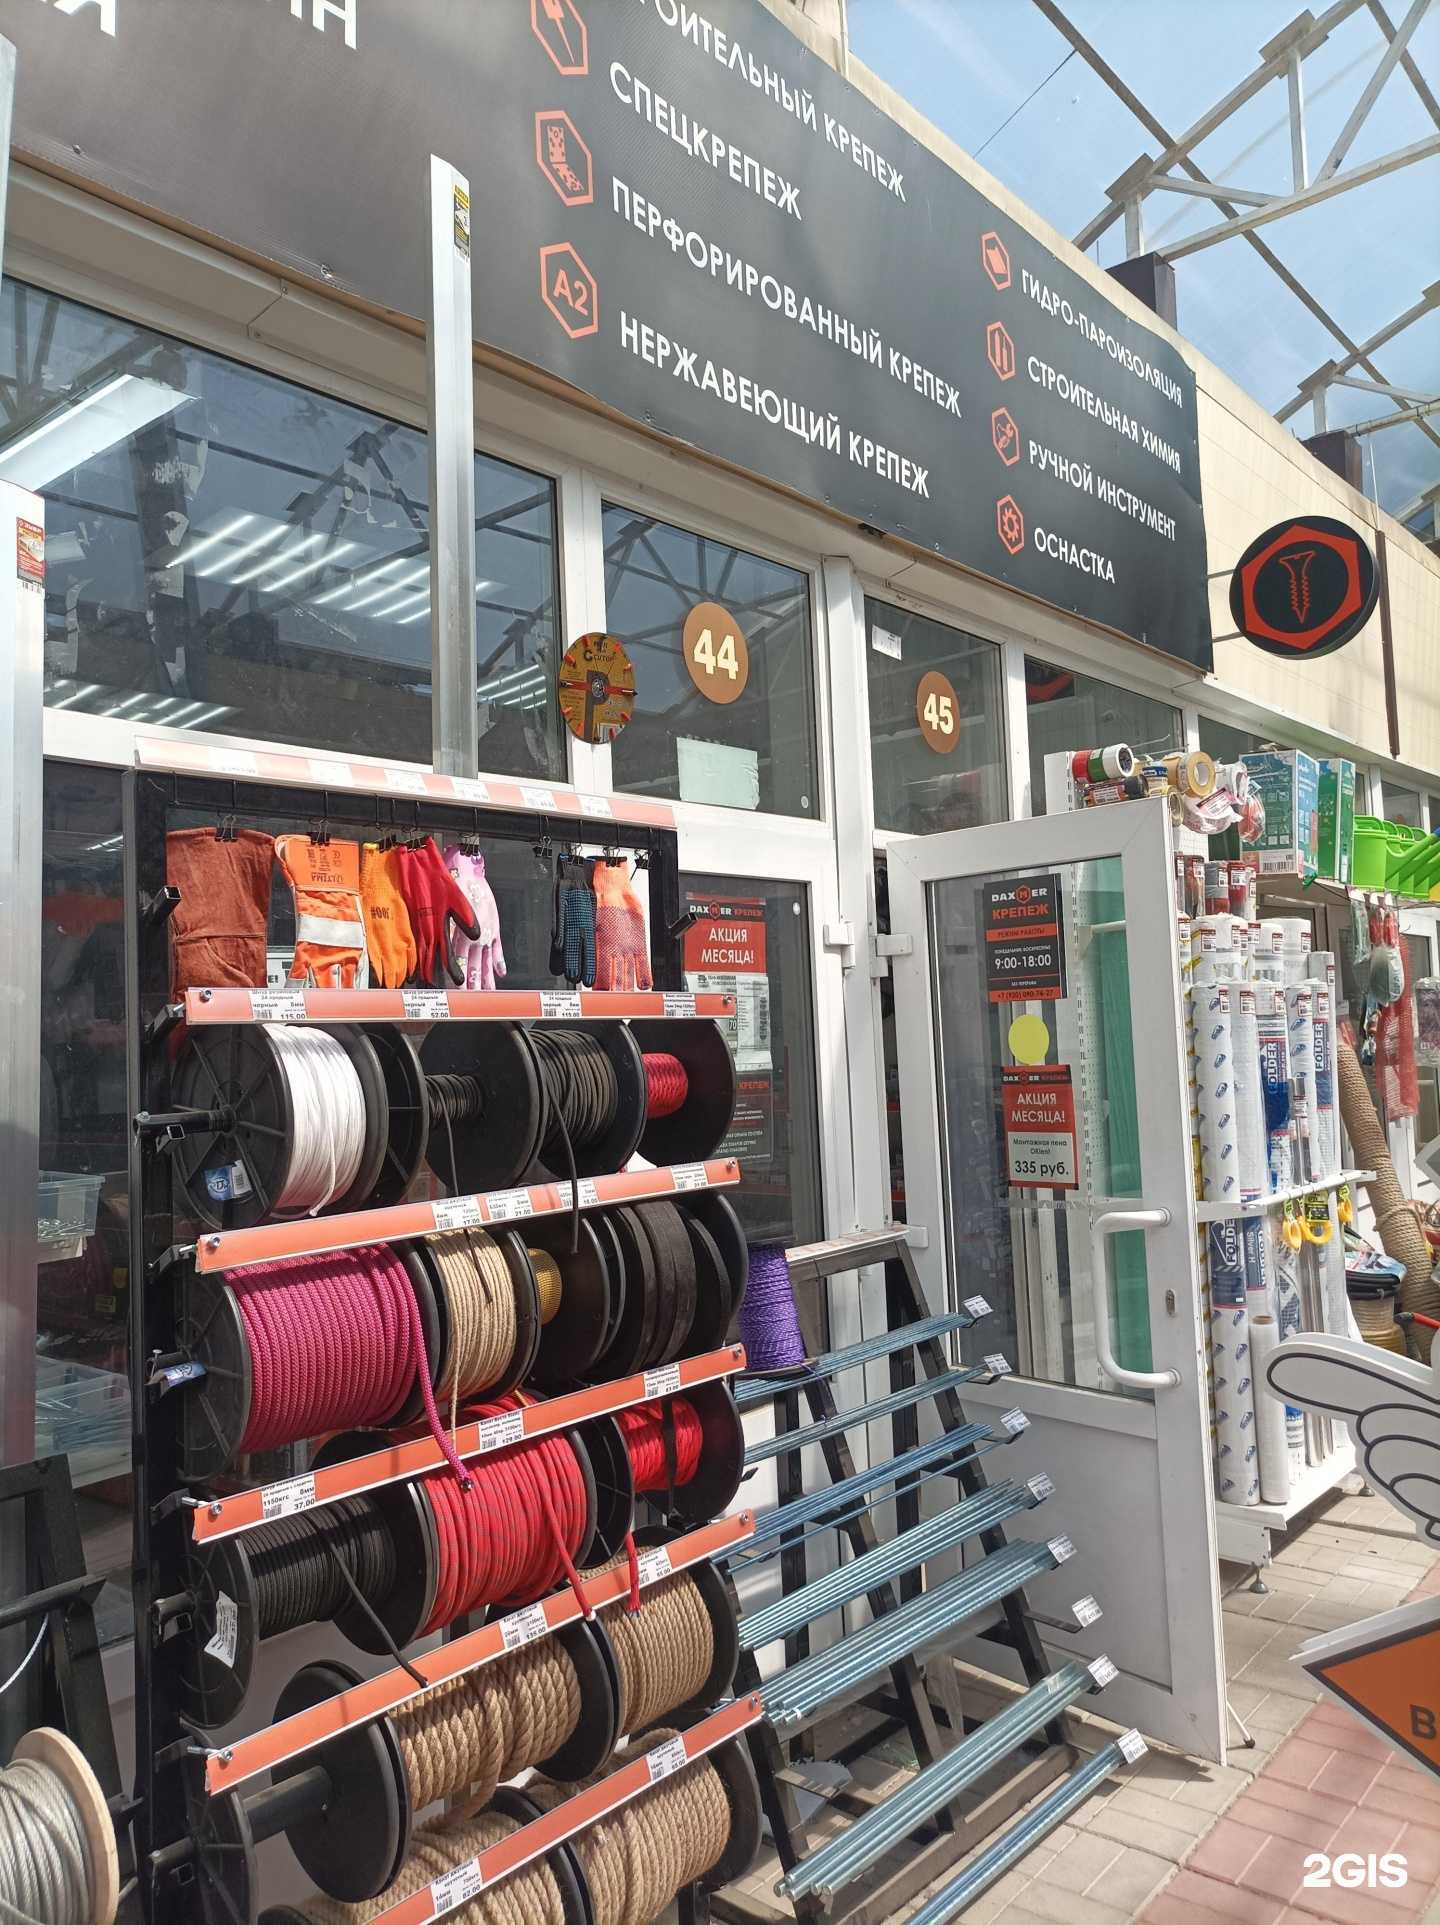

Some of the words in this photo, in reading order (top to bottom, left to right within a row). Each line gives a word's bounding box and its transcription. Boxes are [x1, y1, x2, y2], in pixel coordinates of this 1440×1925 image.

[639, 0, 817, 132] ОИТЕЛЬНЫЙ
[824, 113, 906, 202] КРЕПЕЖ
[610, 62, 802, 221] СПЕЦКРЕПЕЖ
[613, 177, 882, 369] ПЕРФОРИРОВАННЫЙ
[890, 348, 962, 418] КРЕПЕЖ
[1022, 269, 1183, 408] ГИДРО-ПАРОИЗОЛЯЦИЯ
[620, 311, 842, 455] НЕРЖАВЕЮЩИЙ
[849, 432, 929, 499] КРЕПЕЖ
[1028, 356, 1139, 441] СТРОИТЕЛЬНАЯ
[1142, 425, 1181, 475] ХИМИЯ
[1029, 440, 1093, 495] РУЧНОЙ
[1097, 475, 1176, 542] ИНСТРУМЕНТ
[1034, 527, 1115, 584] ОСНАСТКА
[693, 628, 739, 680] 44
[923, 692, 954, 735] 45
[709, 927, 748, 944] АКЦИЯ
[992, 903, 1049, 920] КРЕПЕЖ
[701, 948, 754, 966] МЕСЯЦА!
[995, 954, 1051, 969] 9:00-18:00
[1314, 1023, 1324, 1071] FOLDER
[1011, 1110, 1066, 1124] МЕСЯЦА!
[1017, 1092, 1057, 1107] АКЦИЯ
[1015, 1160, 1036, 1174] 335
[1040, 1161, 1069, 1177] руб.
[1225, 1218, 1236, 1264] FOLDE
